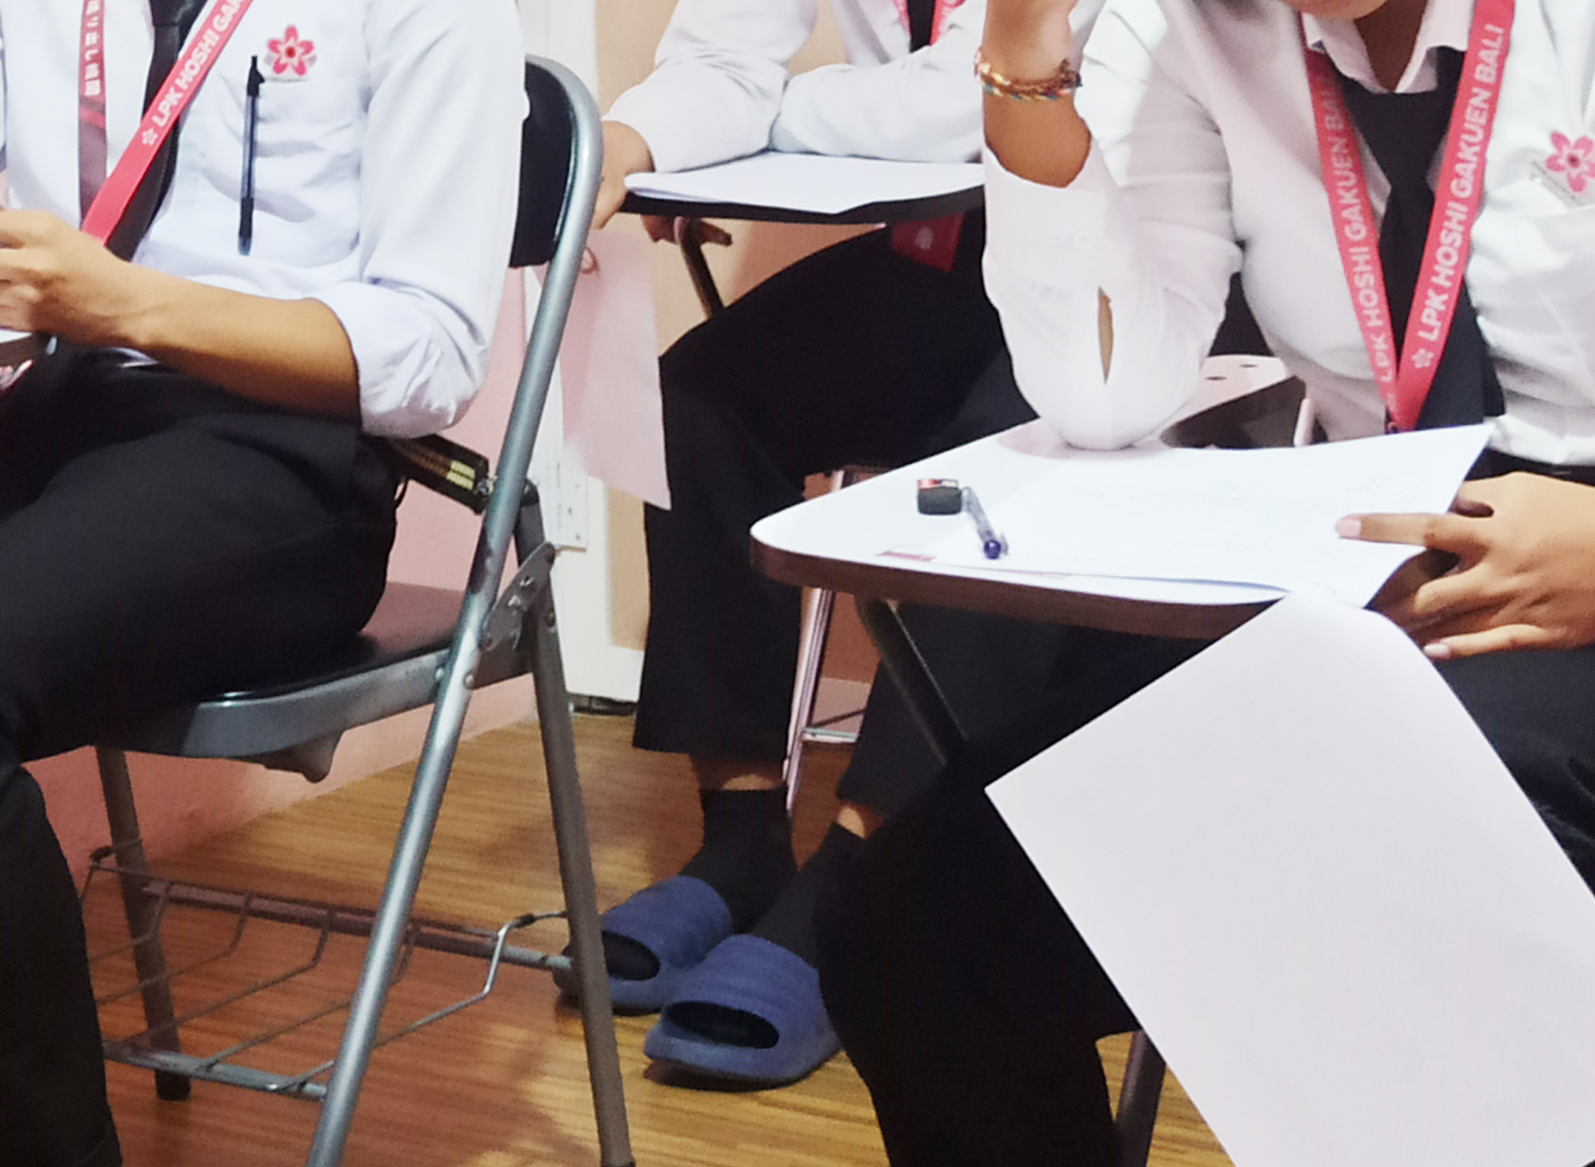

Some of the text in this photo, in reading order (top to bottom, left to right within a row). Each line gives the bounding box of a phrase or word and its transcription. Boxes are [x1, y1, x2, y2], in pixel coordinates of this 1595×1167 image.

[152, 86, 184, 127] LPK
[179, 27, 220, 88] HOSHI
[1328, 137, 1368, 242] GAKUEN
[1417, 23, 1504, 343] LPK HOSHI GAKUEN BALI
[1349, 246, 1383, 328] HOSHI
[1370, 332, 1394, 383] LPK
